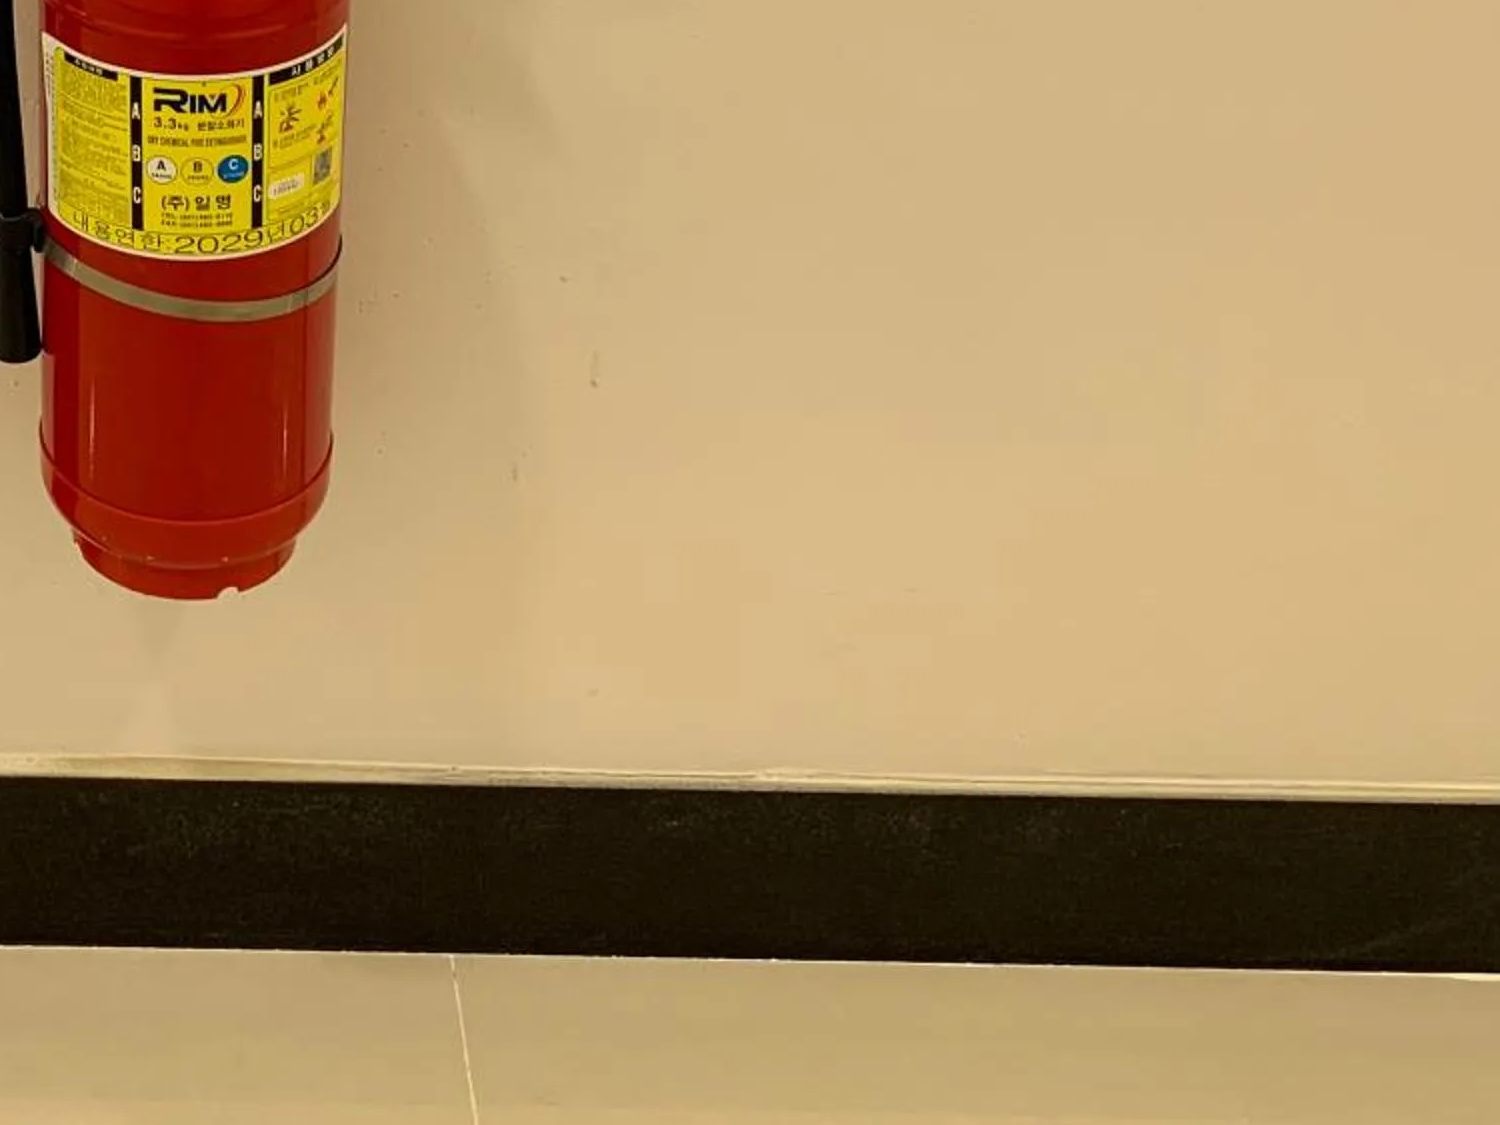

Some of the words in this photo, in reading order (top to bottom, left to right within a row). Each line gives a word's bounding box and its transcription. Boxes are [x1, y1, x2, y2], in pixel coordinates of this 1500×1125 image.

[153, 87, 227, 114] RIM
[131, 102, 141, 120] A
[253, 101, 263, 119] A
[132, 144, 142, 162] B
[253, 143, 263, 161] B
[157, 159, 166, 171] A
[228, 158, 239, 171] C
[133, 186, 142, 204] C
[253, 185, 263, 203] C
